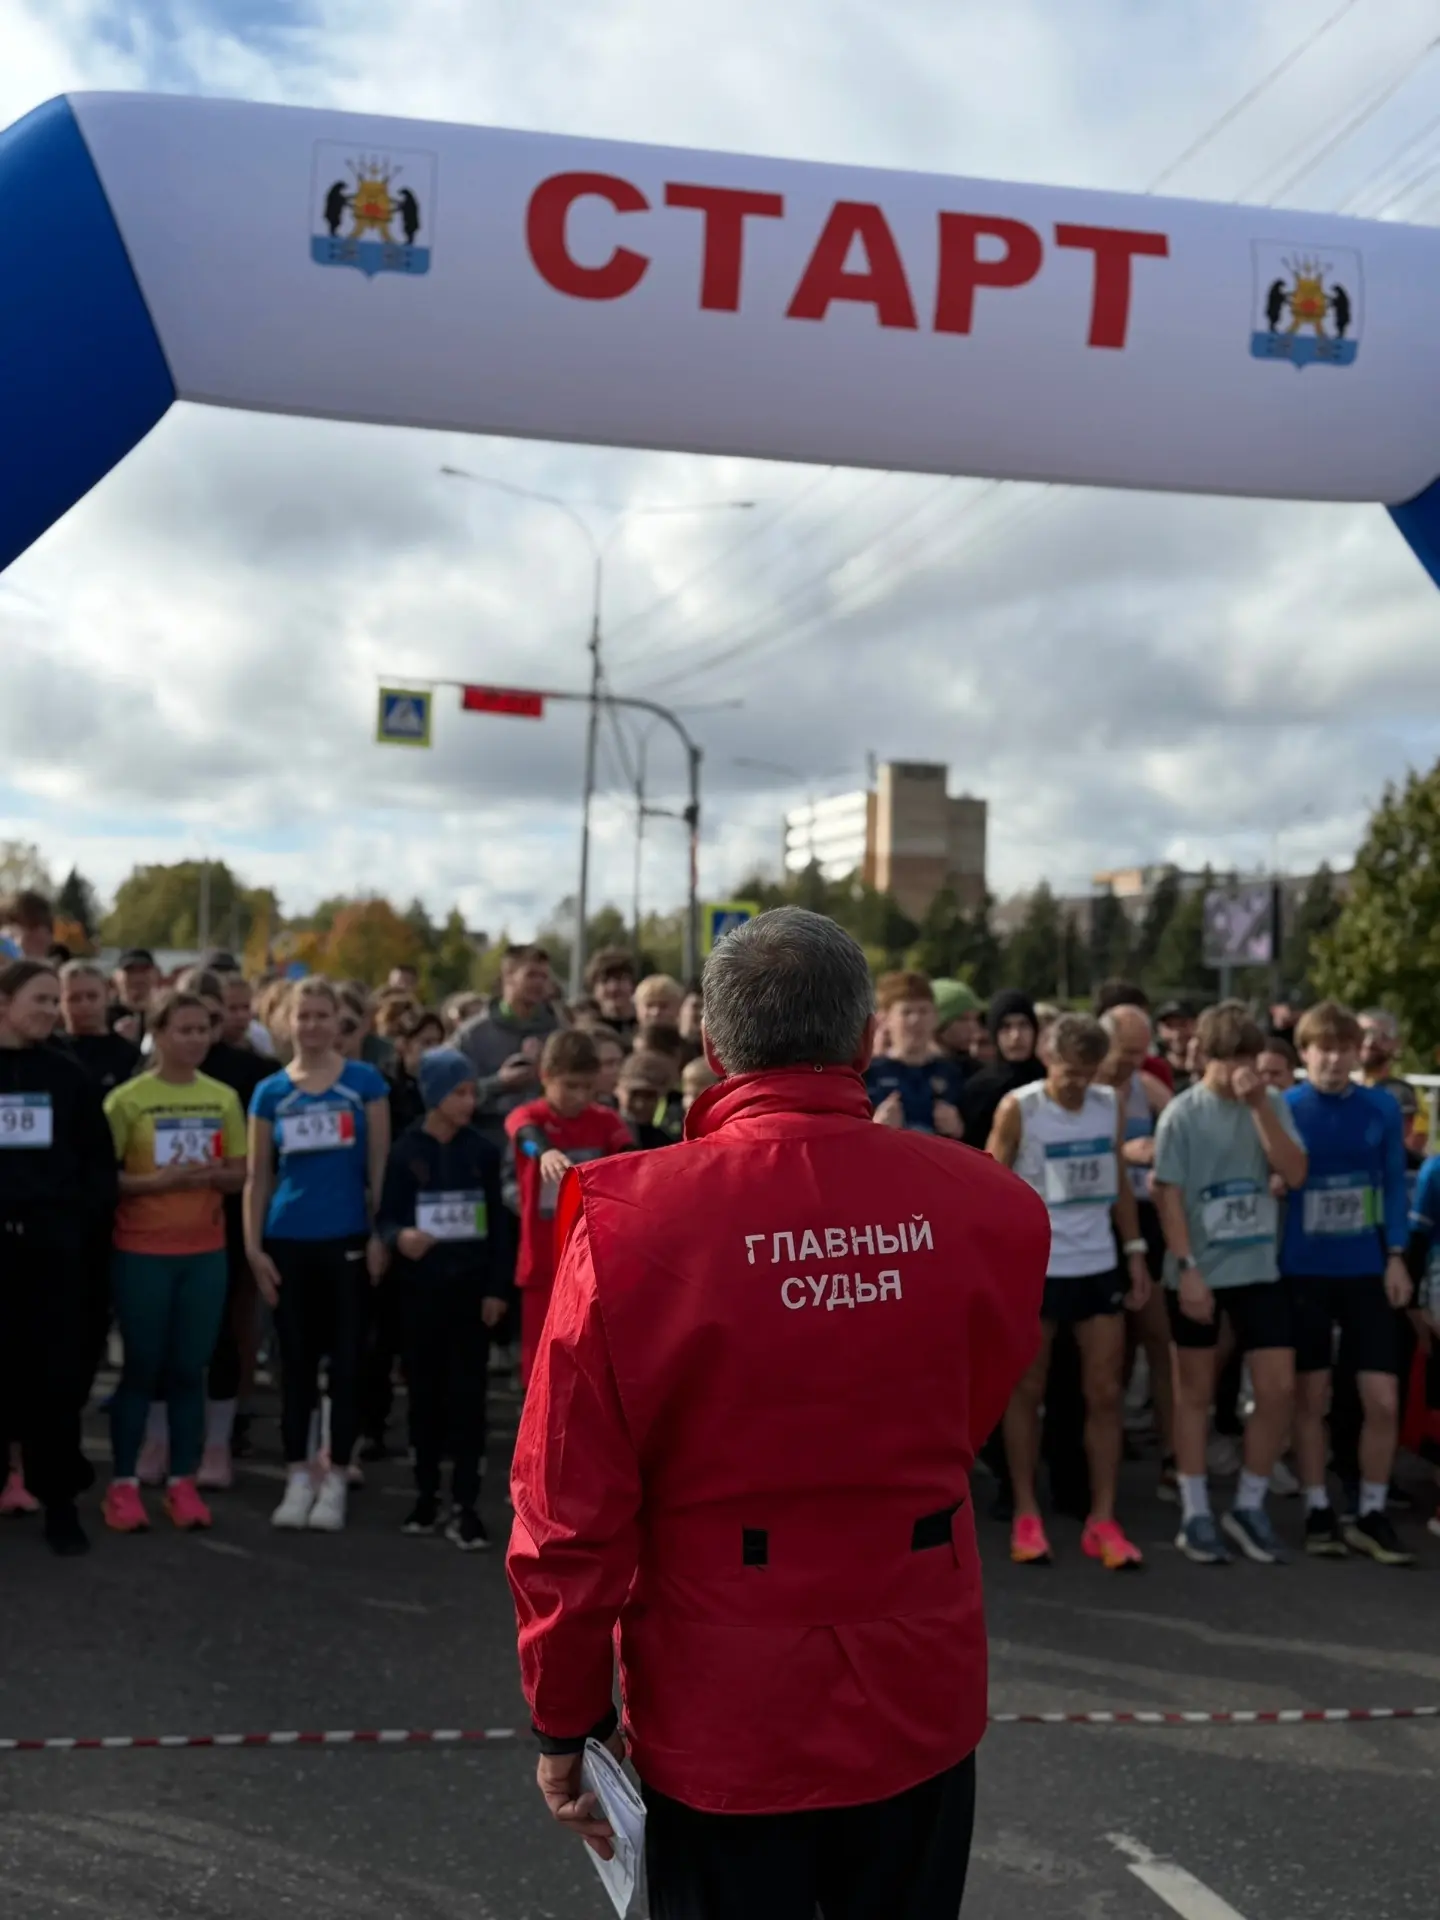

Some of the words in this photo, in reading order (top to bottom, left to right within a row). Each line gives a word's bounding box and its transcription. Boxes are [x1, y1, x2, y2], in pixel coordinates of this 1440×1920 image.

[525, 170, 1170, 350] СТАРТ
[745, 1213, 934, 1265] ГЛАВНЫЙ
[781, 1269, 903, 1312] СУДЬЯ
